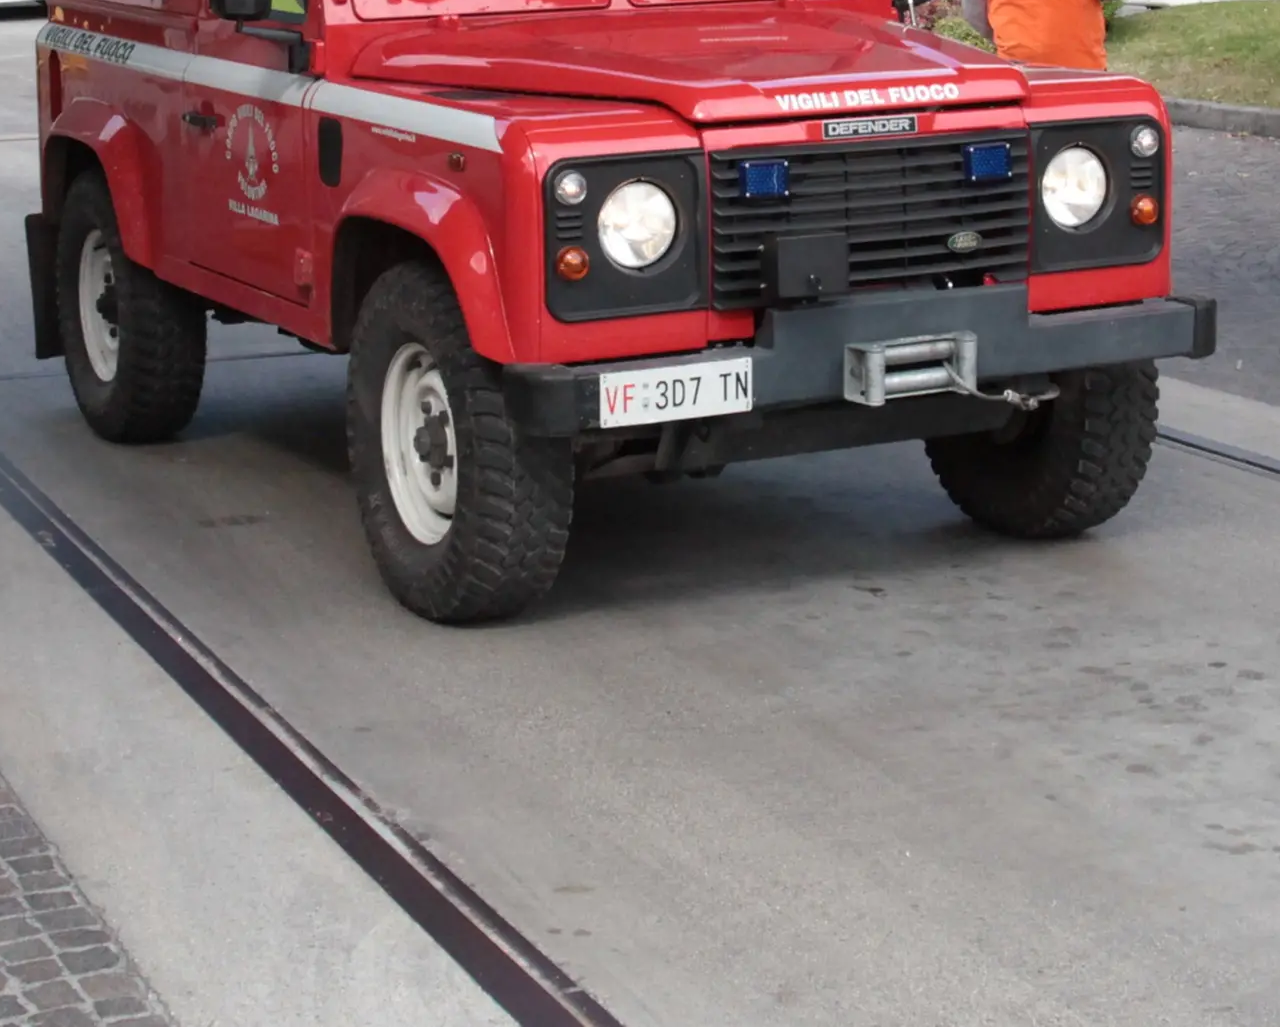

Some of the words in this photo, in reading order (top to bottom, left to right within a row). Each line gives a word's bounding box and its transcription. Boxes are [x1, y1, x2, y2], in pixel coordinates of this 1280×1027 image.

[45, 26, 76, 49] VIGILI
[73, 32, 97, 52] DEL
[94, 37, 136, 64] FUOCO
[775, 90, 840, 111] VIGILI
[843, 88, 885, 107] DEL
[887, 82, 960, 104] FUOCO
[827, 118, 912, 136] DEFENDER
[605, 383, 637, 416] VF
[655, 376, 703, 411] 3D7
[719, 370, 749, 402] TN
